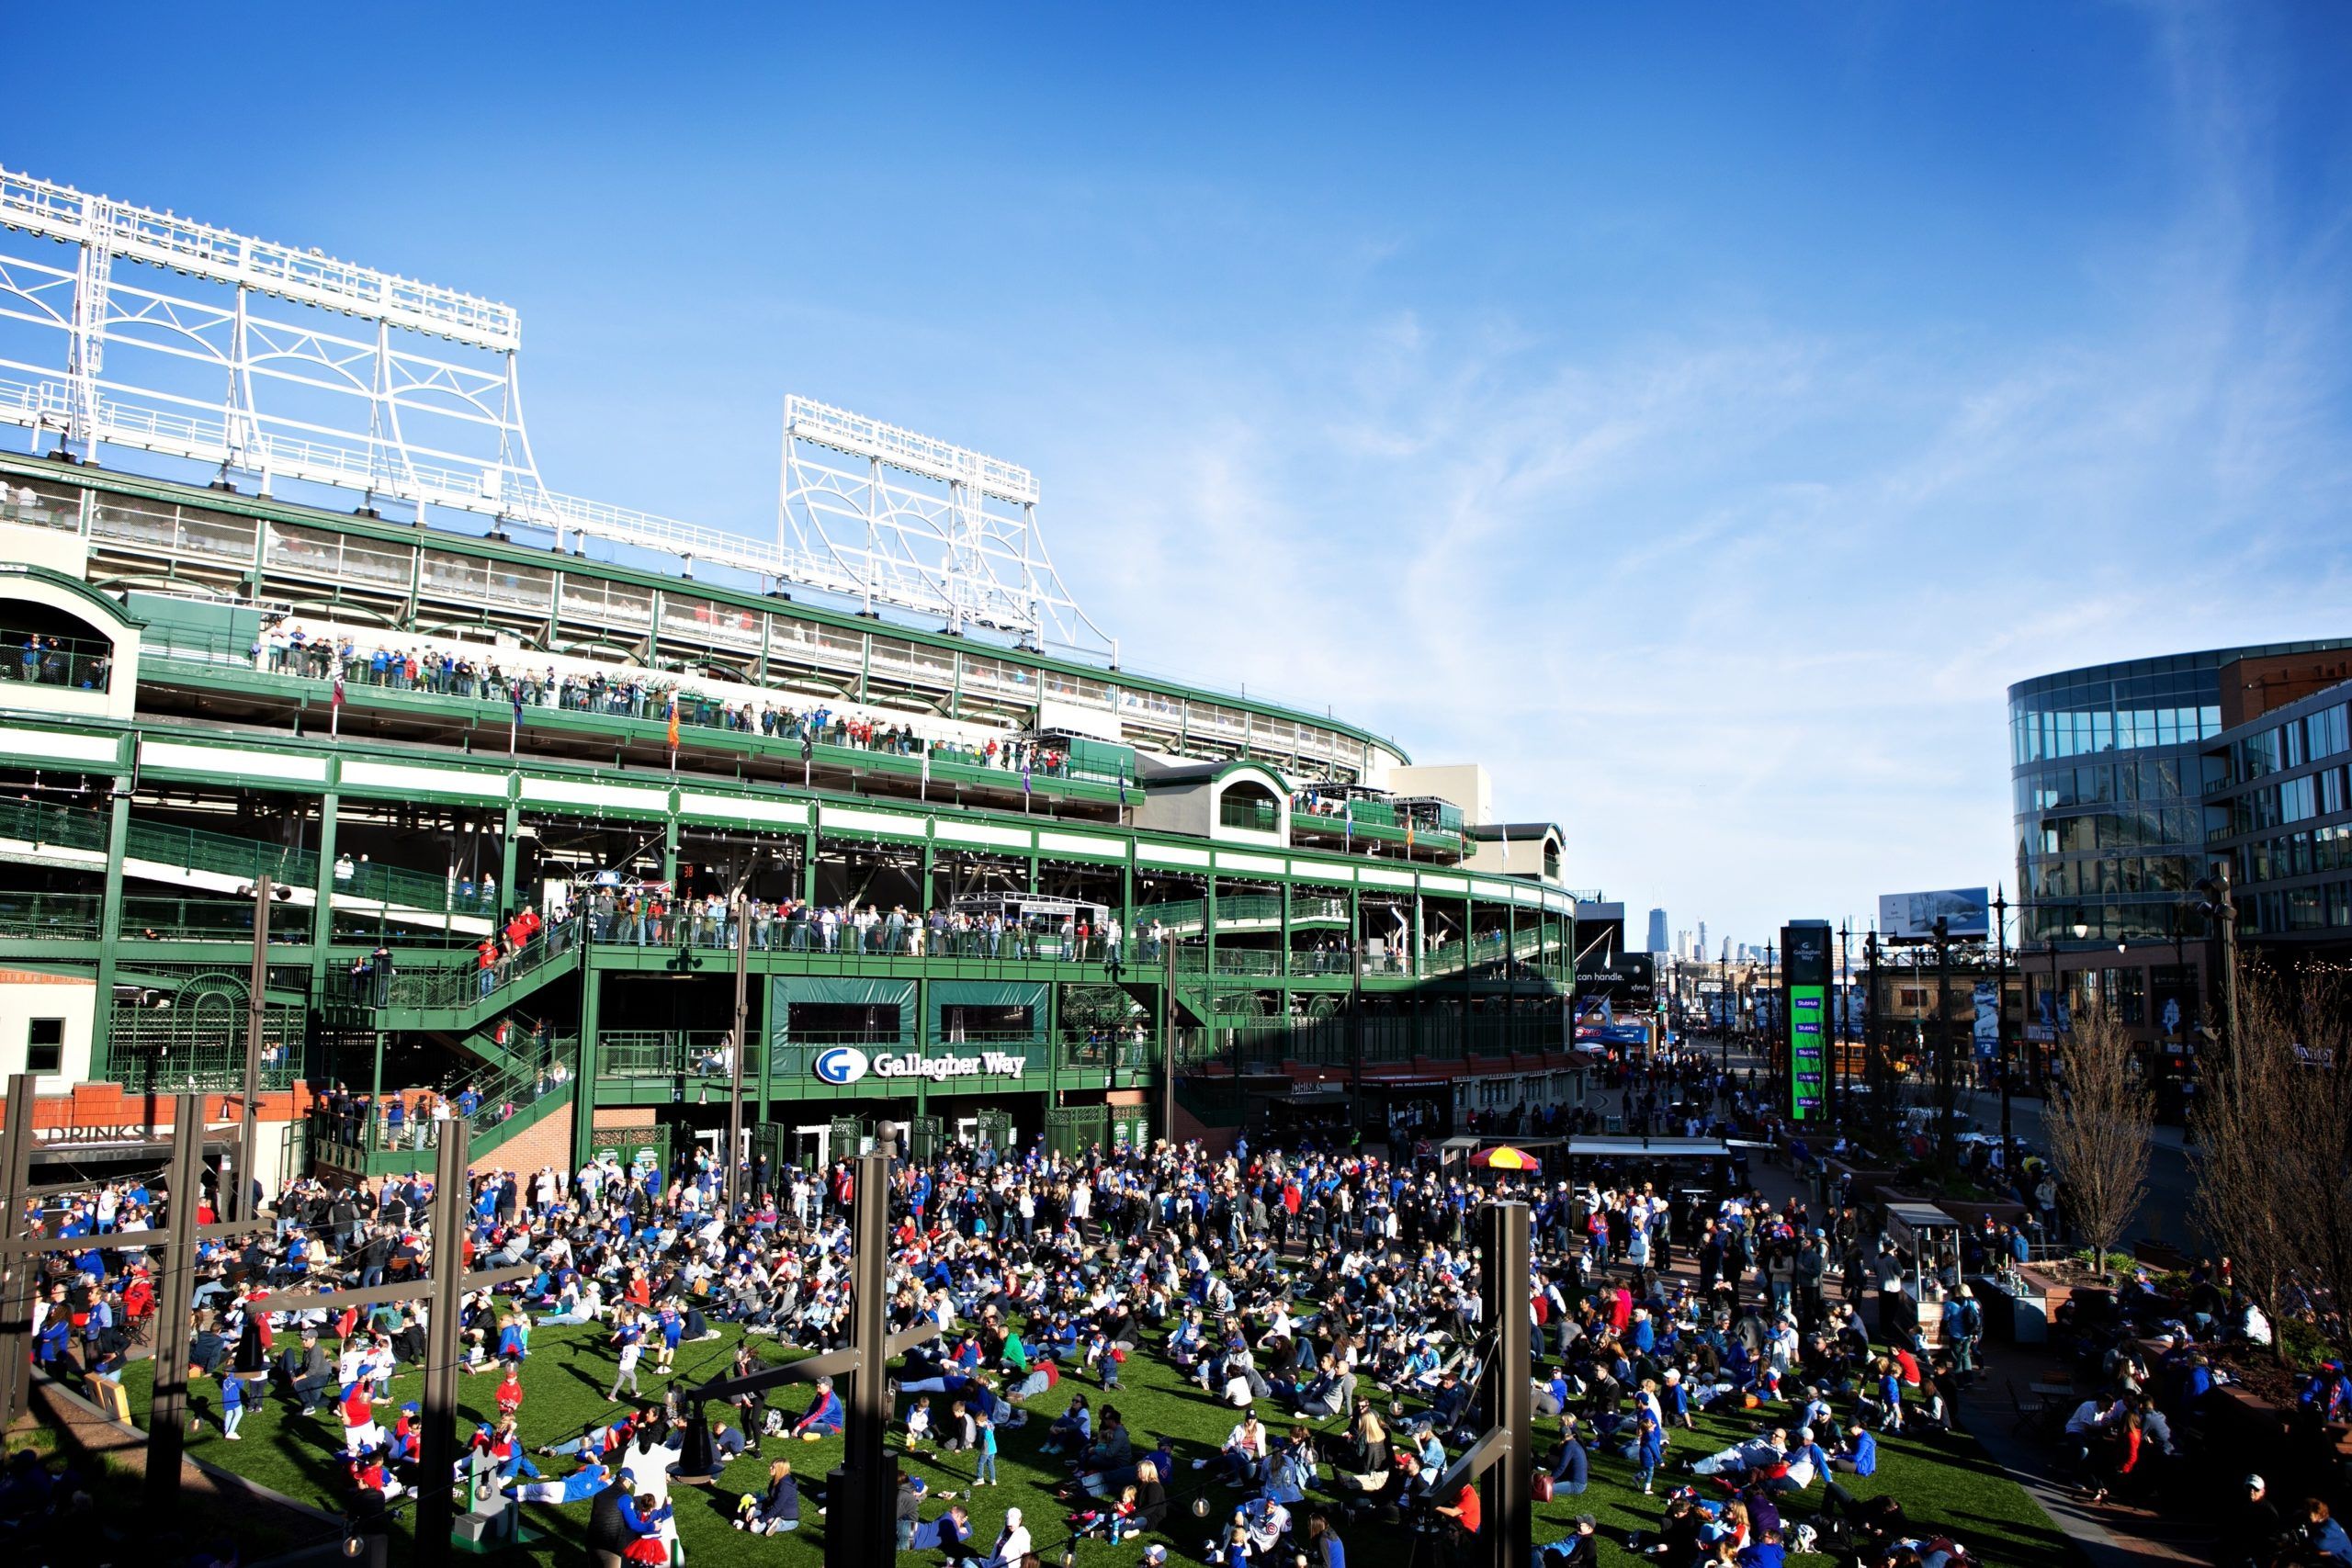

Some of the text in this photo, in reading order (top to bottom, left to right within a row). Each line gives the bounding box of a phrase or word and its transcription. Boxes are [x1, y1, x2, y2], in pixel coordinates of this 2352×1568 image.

[684, 865, 694, 877] 38
[1594, 972, 1625, 981] handle.
[874, 1052, 1026, 1081] Gallagher Way
[1292, 1081, 1323, 1093] DRINKS
[45, 1123, 146, 1145] DRINKS
